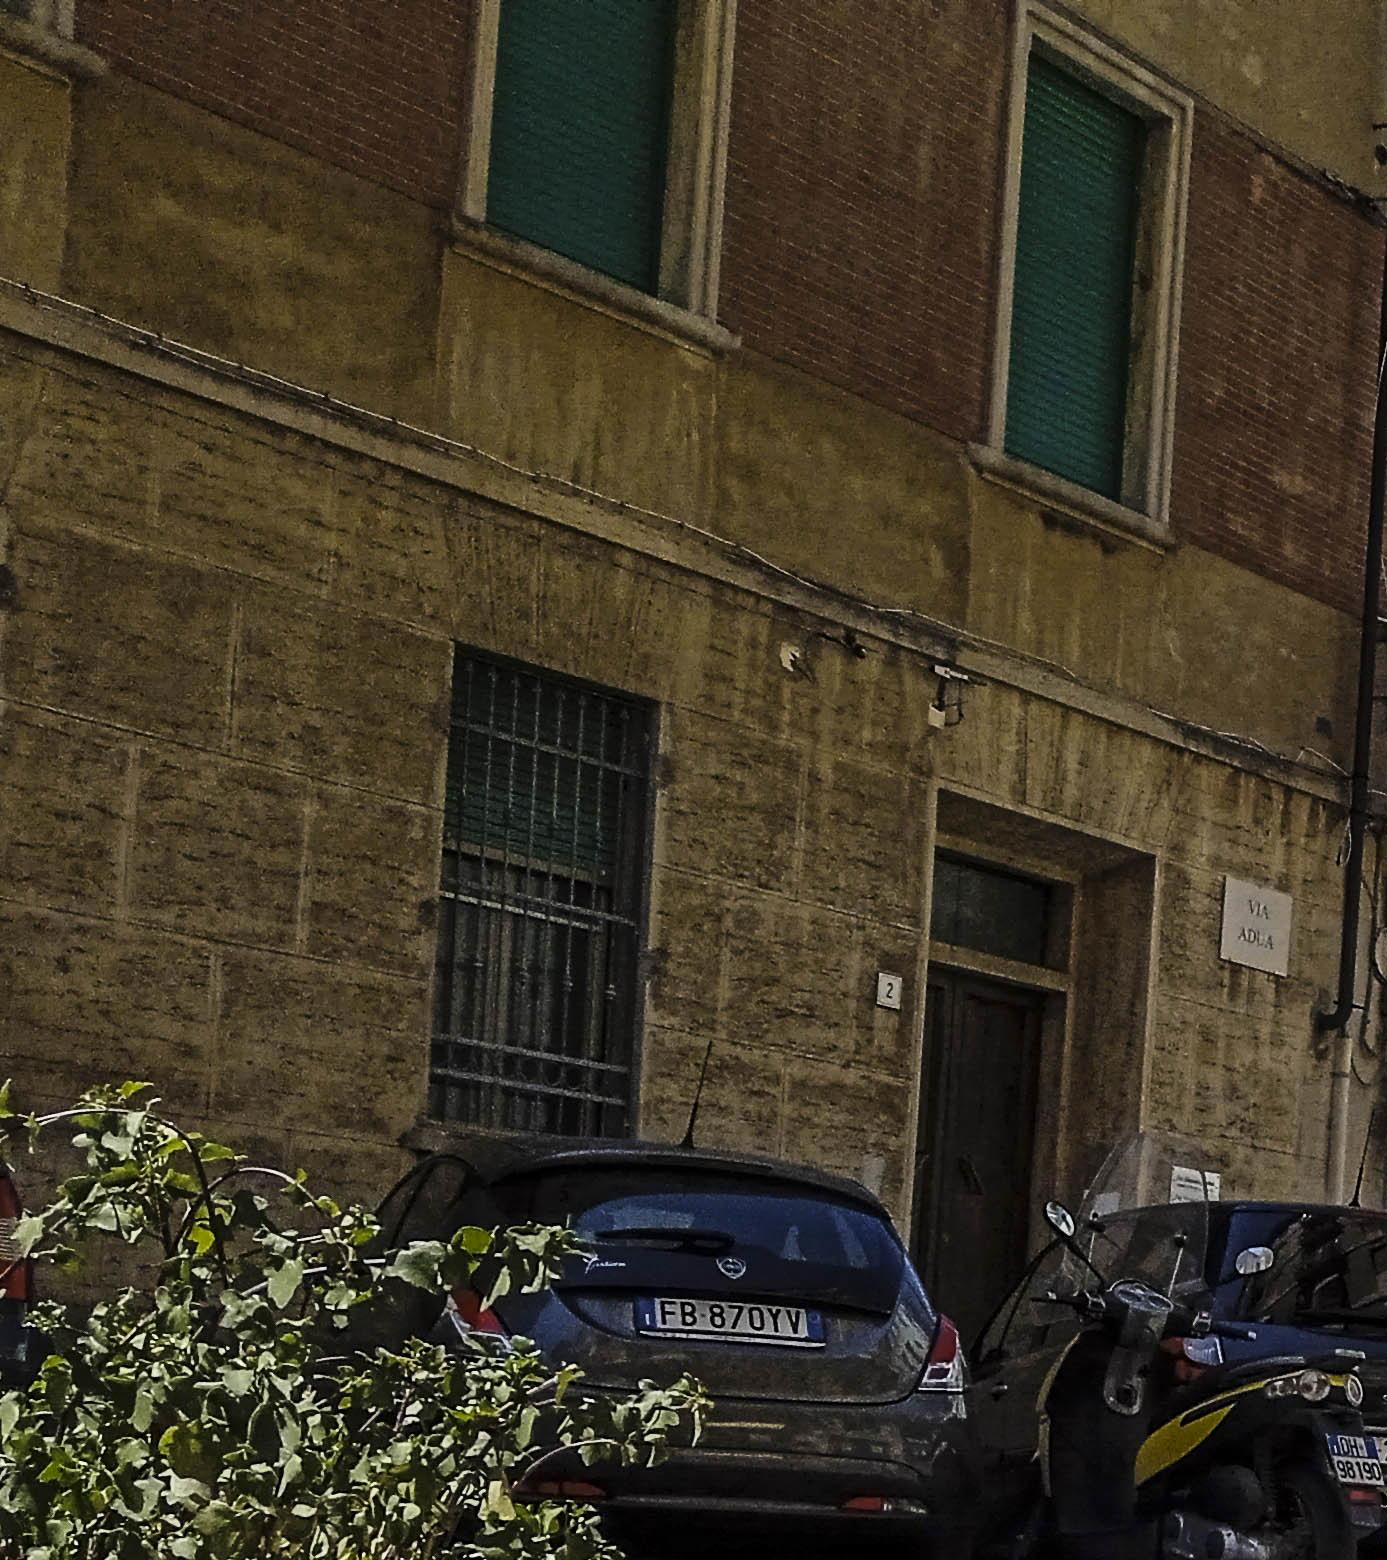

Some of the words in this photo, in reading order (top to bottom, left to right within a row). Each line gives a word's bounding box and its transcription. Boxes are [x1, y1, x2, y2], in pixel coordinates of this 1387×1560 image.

[1248, 899, 1269, 920] VIA
[1238, 926, 1274, 950] ADUA
[886, 982, 894, 999] 2
[1337, 1461, 1381, 1481] 98190
